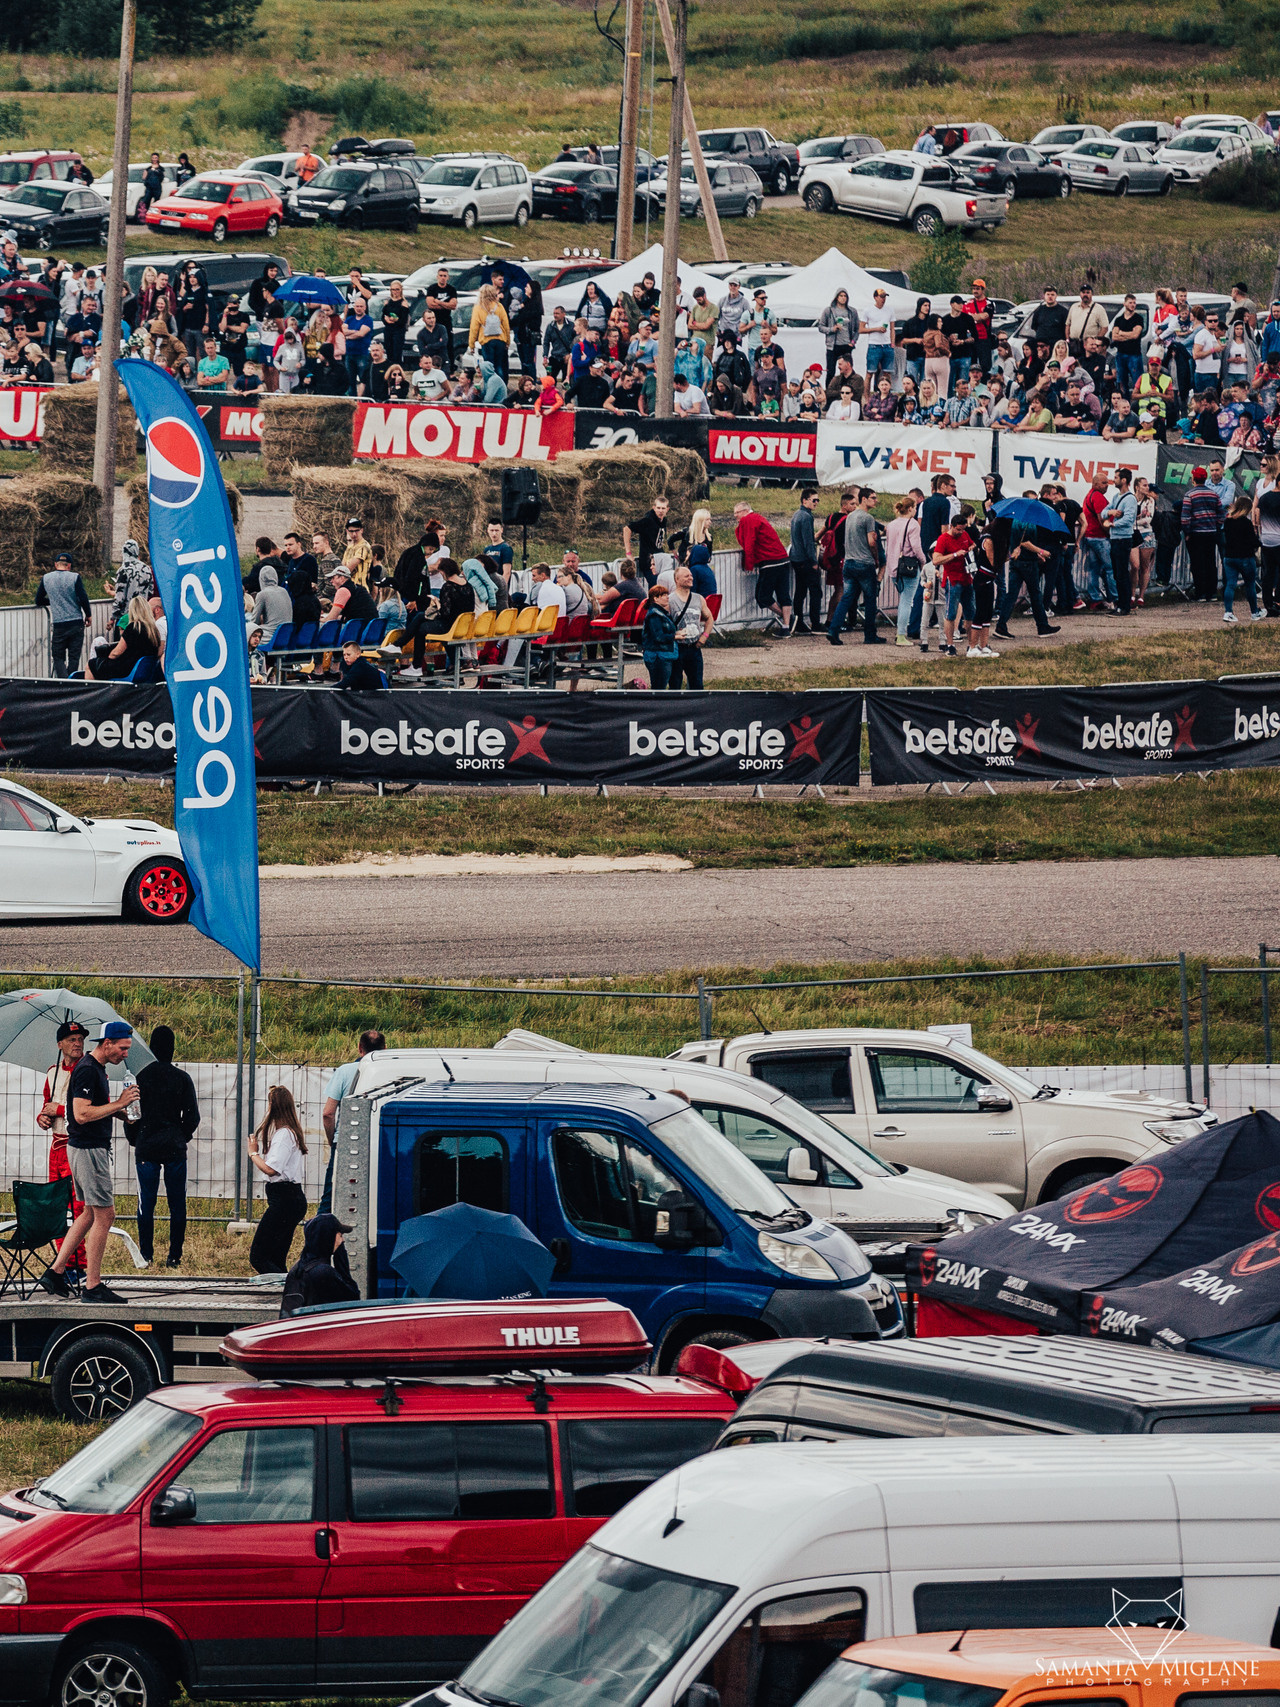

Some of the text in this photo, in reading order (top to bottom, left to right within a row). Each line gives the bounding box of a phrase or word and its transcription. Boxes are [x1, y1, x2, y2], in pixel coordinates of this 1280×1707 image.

[356, 406, 551, 462] MOTUL
[714, 434, 815, 464] MOTUL
[70, 711, 177, 750] betsa
[340, 719, 507, 756] betsafe
[628, 720, 787, 757] betsafe
[902, 718, 1017, 755] betsafe
[1082, 711, 1174, 751] betsafe
[1234, 704, 1280, 741] bets
[455, 758, 506, 770] SPORTS
[738, 758, 785, 771] SPORTS
[984, 754, 1015, 767] SPORTS
[1143, 748, 1174, 760] SPORTS
[1008, 1213, 1087, 1253] 24MX
[935, 1258, 990, 1291] 24MX
[1177, 1268, 1244, 1306] 24MX
[500, 1326, 581, 1347] THULE
